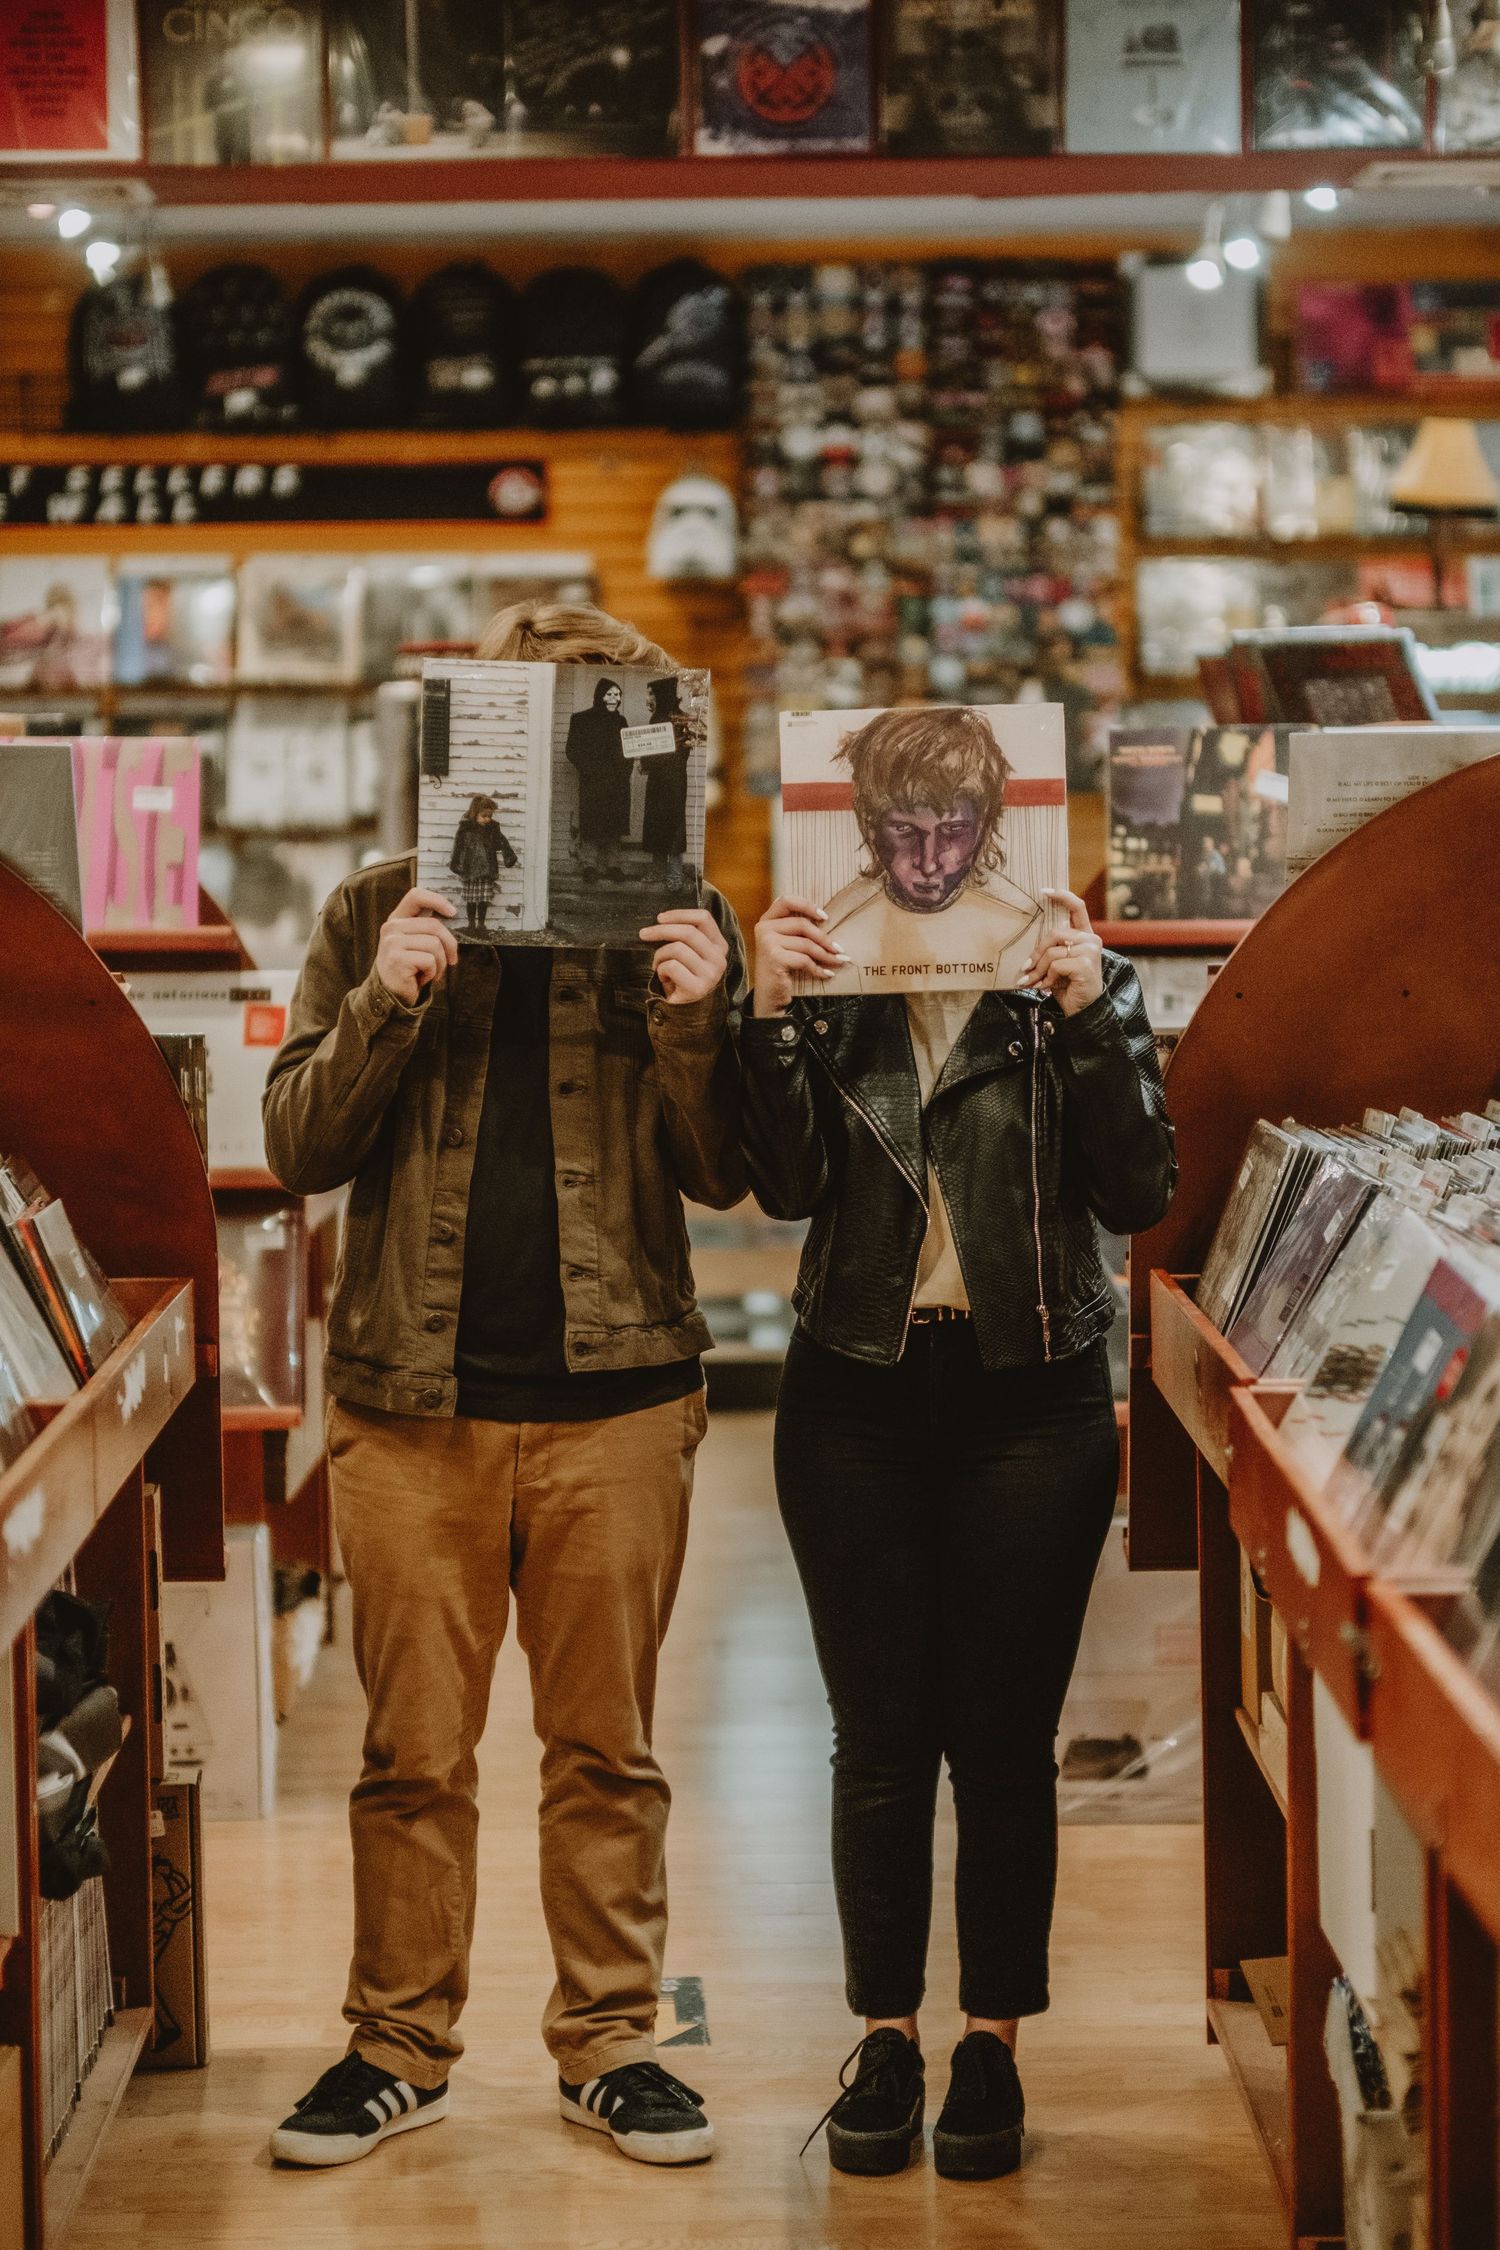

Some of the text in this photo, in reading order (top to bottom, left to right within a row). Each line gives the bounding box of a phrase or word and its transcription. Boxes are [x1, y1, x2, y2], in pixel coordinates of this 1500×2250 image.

[863, 962, 994, 976] THE FRONT BOTTOMS
